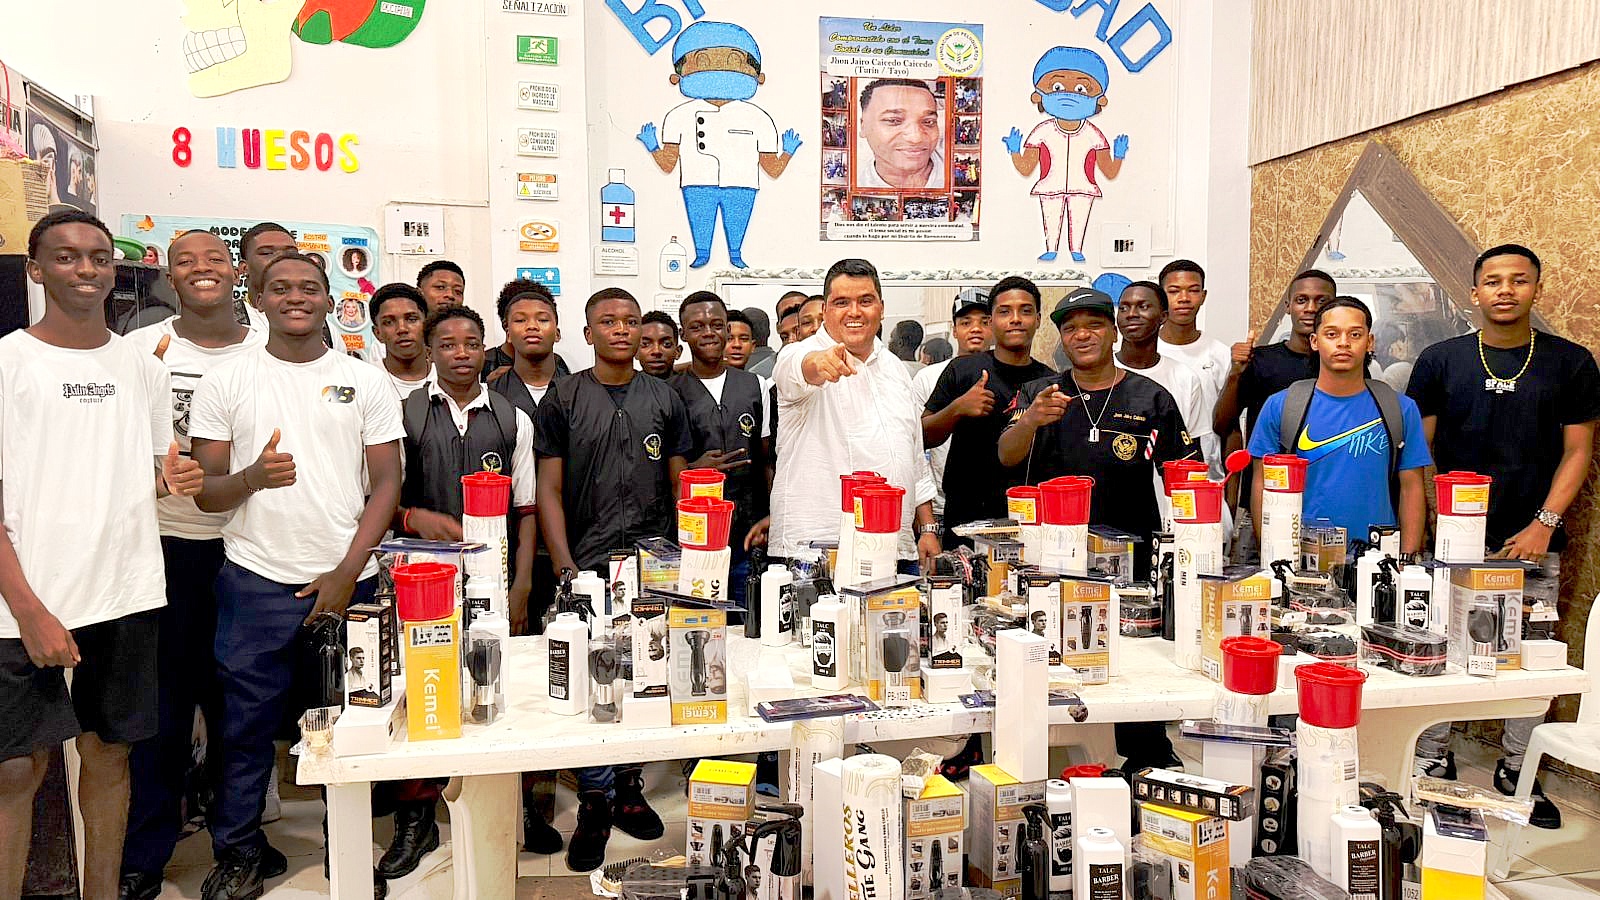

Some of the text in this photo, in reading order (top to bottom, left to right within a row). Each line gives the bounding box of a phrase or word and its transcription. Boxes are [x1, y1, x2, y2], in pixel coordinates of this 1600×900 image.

[1035, 0, 1172, 73] AD
[833, 44, 860, 53] Social
[861, 45, 871, 54] de
[830, 56, 933, 68] Jhon Jairo Caicedo Caicedo
[887, 67, 909, 76] Tayo)
[172, 127, 359, 173] 8 HUESOS
[63, 382, 115, 398] Palm Angels
[1348, 428, 1389, 458] NIKE
[1483, 573, 1515, 583] Kemei
[1073, 584, 1102, 595] Kemei
[1233, 584, 1263, 593] Kemei
[423, 668, 440, 730] Kemei
[682, 707, 718, 719] Kemei
[1351, 849, 1376, 859] BARBER
[1093, 873, 1119, 885] BARBER
[1404, 887, 1419, 900] 1052
